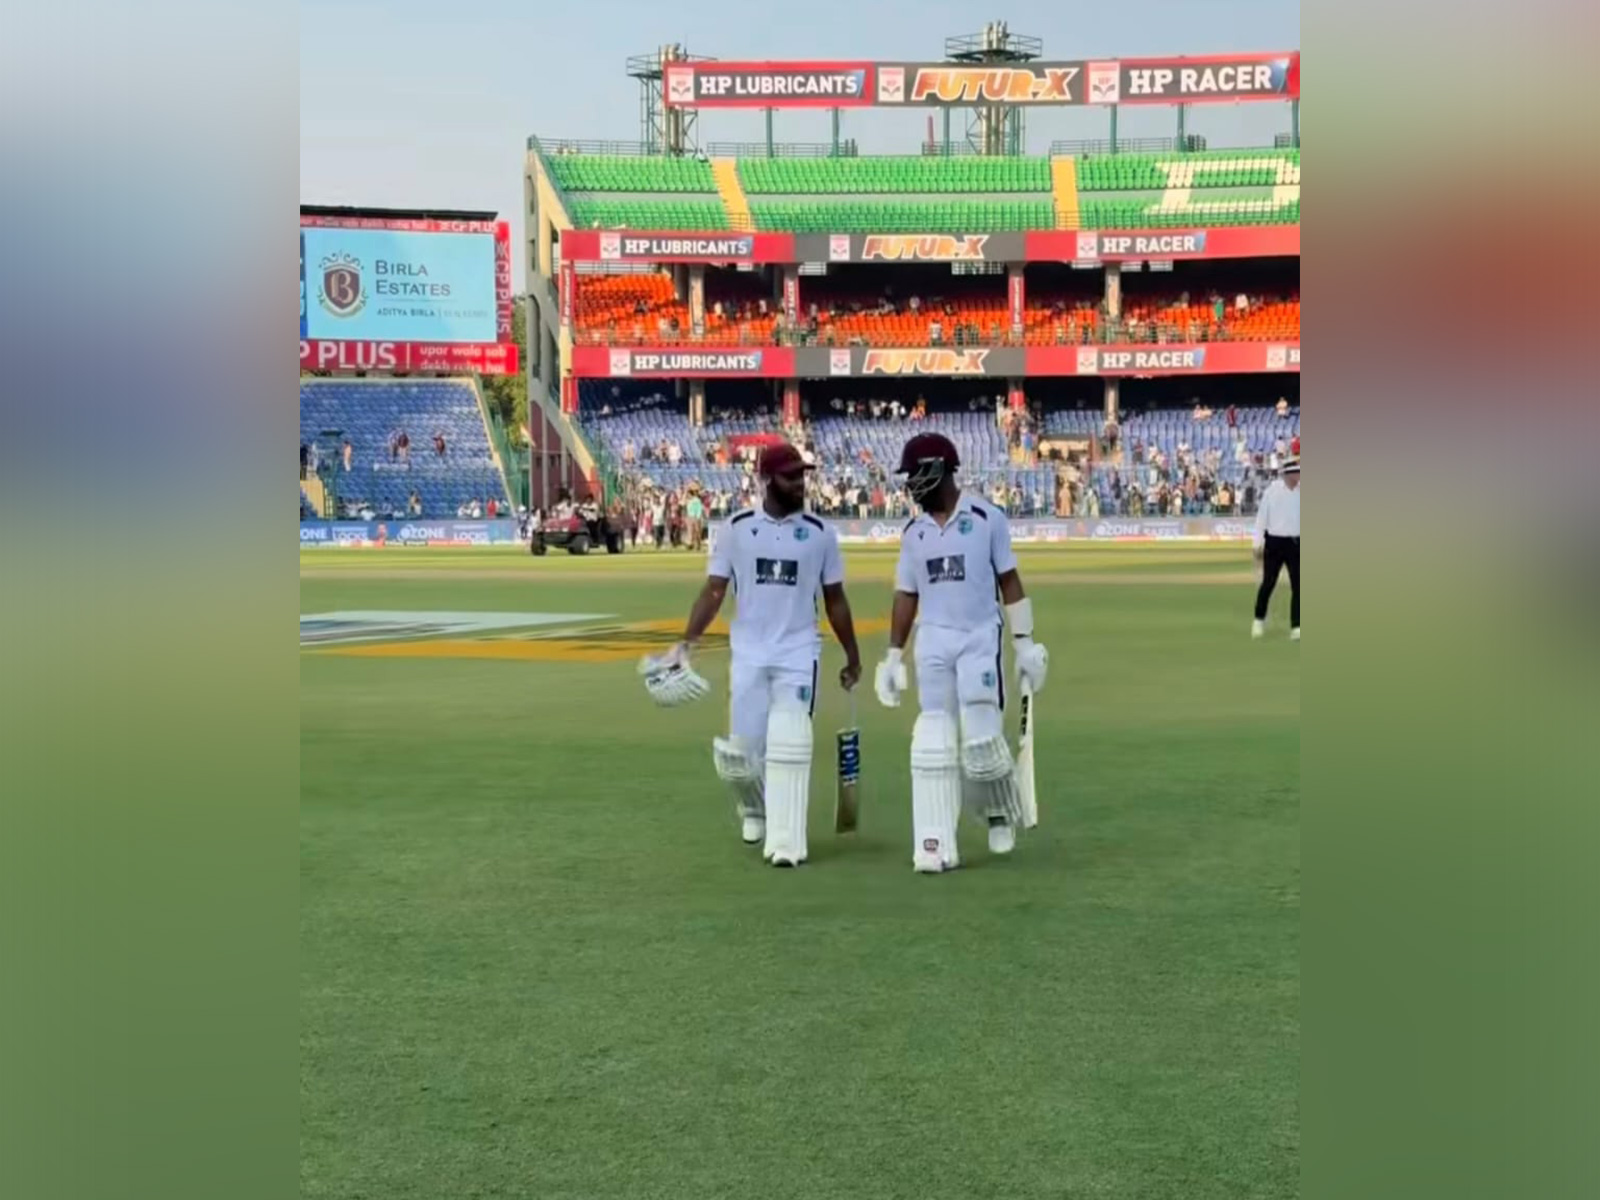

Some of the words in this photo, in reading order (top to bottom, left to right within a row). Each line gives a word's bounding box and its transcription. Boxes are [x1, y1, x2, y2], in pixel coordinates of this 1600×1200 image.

[700, 77, 732, 95] HP
[735, 75, 858, 95] LUBRICANTS
[910, 67, 1080, 101] FUTUR-X
[1129, 69, 1173, 94] HP
[1180, 65, 1272, 93] RACER
[624, 239, 649, 254] HP
[652, 238, 748, 255] LUBRICANTS
[861, 234, 990, 260] FUTUR-X
[1103, 237, 1131, 252] HP
[1135, 235, 1195, 252] RACER
[318, 341, 398, 369] PLUS
[634, 356, 660, 370] HP
[662, 354, 757, 370] LUBRICANTS
[862, 349, 990, 374] FUTUR-X
[1103, 353, 1131, 369] HP
[1135, 351, 1195, 369] RACER
